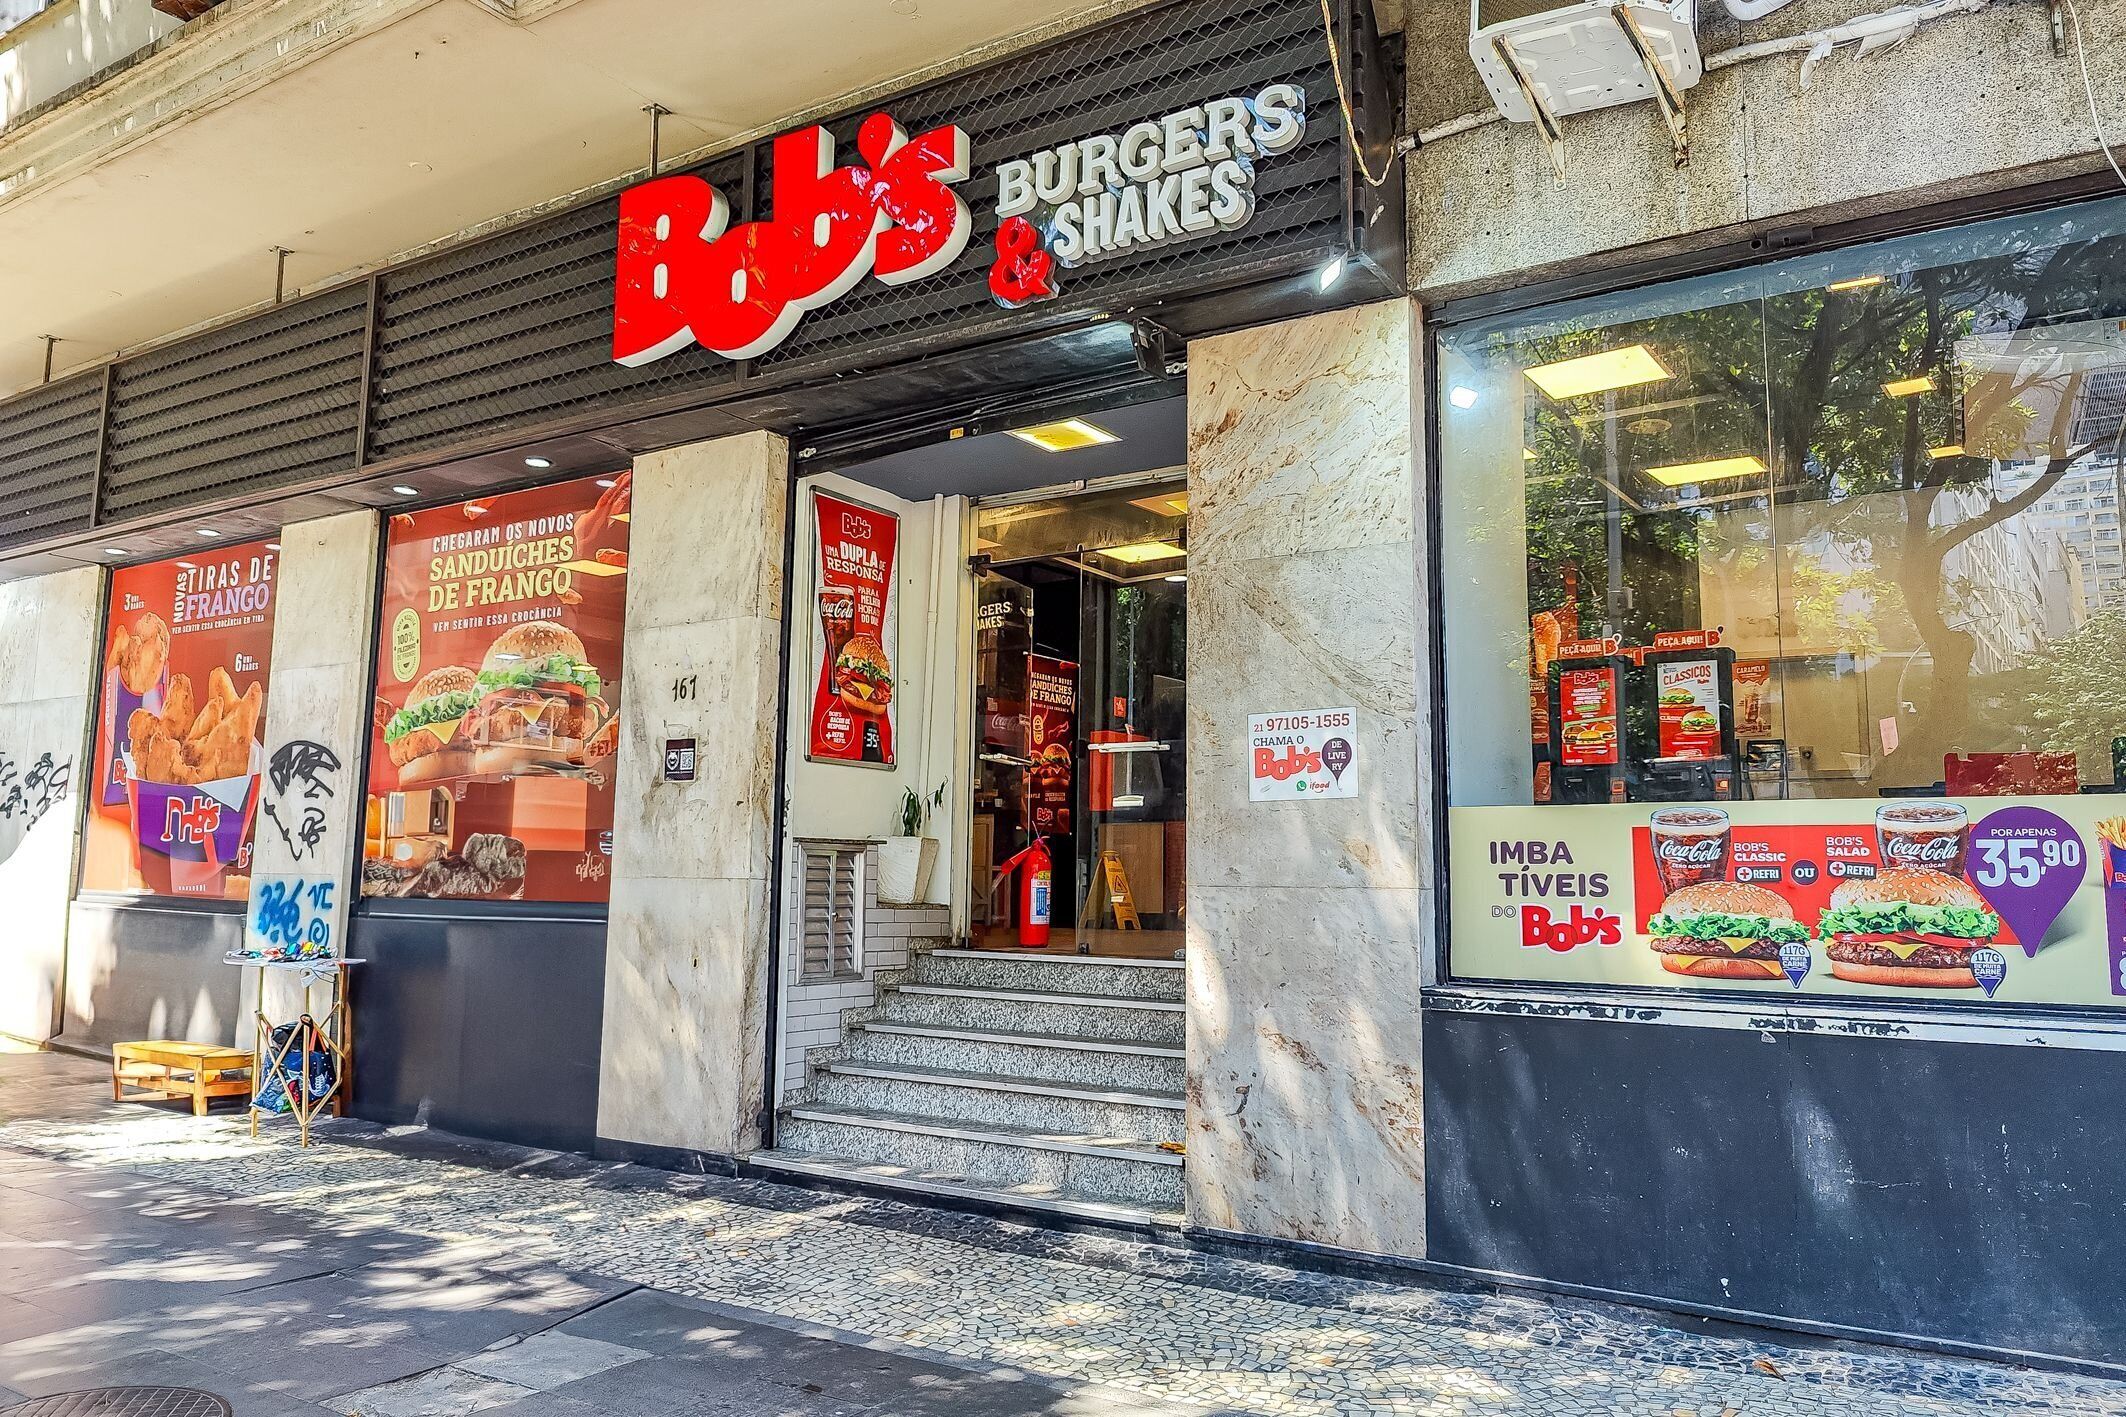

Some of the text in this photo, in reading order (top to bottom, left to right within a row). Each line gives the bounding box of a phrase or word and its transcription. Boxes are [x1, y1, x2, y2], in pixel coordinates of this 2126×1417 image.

[996, 83, 1306, 218] BURGERS
[613, 112, 971, 367] Bob's
[988, 160, 1256, 308] & SHAKES
[433, 513, 574, 554] CHEGARAM OS NOVOS
[842, 512, 871, 538] Bob's
[430, 535, 574, 582] SANDUÍCHES
[825, 540, 886, 571] UMA DUPLA DE
[187, 554, 273, 593] TIRAS DE
[826, 556, 883, 584] RESPONSA
[173, 572, 187, 623] NOVAS
[427, 567, 572, 612] DE FRANGO
[124, 594, 131, 611] 3
[184, 583, 270, 621] FRANGO
[433, 606, 562, 633] VEM SENTIR ESSA CROCÂNCIA
[235, 653, 242, 672] 6
[1736, 665, 1765, 673] CARAMELO
[1040, 690, 1072, 706] FRANGO
[1254, 713, 1350, 732] 21 97105-1555
[1253, 735, 1304, 746] CHAMA O
[1331, 741, 1342, 749] DE
[1254, 745, 1322, 780] Bob's
[1328, 752, 1346, 760] LIVE
[1331, 763, 1343, 771] RY
[1826, 836, 1863, 846] BOB'S
[1991, 828, 2057, 837] POR APENAS
[1490, 841, 1574, 865] IMBA
[1659, 838, 1722, 863] Coca-Cola
[1734, 842, 1769, 851] BOB'S
[1734, 853, 1786, 862] CLASSIC
[1826, 846, 1870, 857] SALAD
[1887, 835, 1960, 862] Coca-Cola
[1753, 869, 1779, 879] REFRI
[1794, 867, 1815, 878] OU
[1846, 866, 1874, 877] REFRI
[1975, 839, 2080, 888] 35,90
[1499, 865, 1609, 897] TÍVEIS
[1491, 904, 1622, 952] DO Bob's
[1783, 946, 1806, 955] 117G
[1975, 952, 1999, 962] 117G
